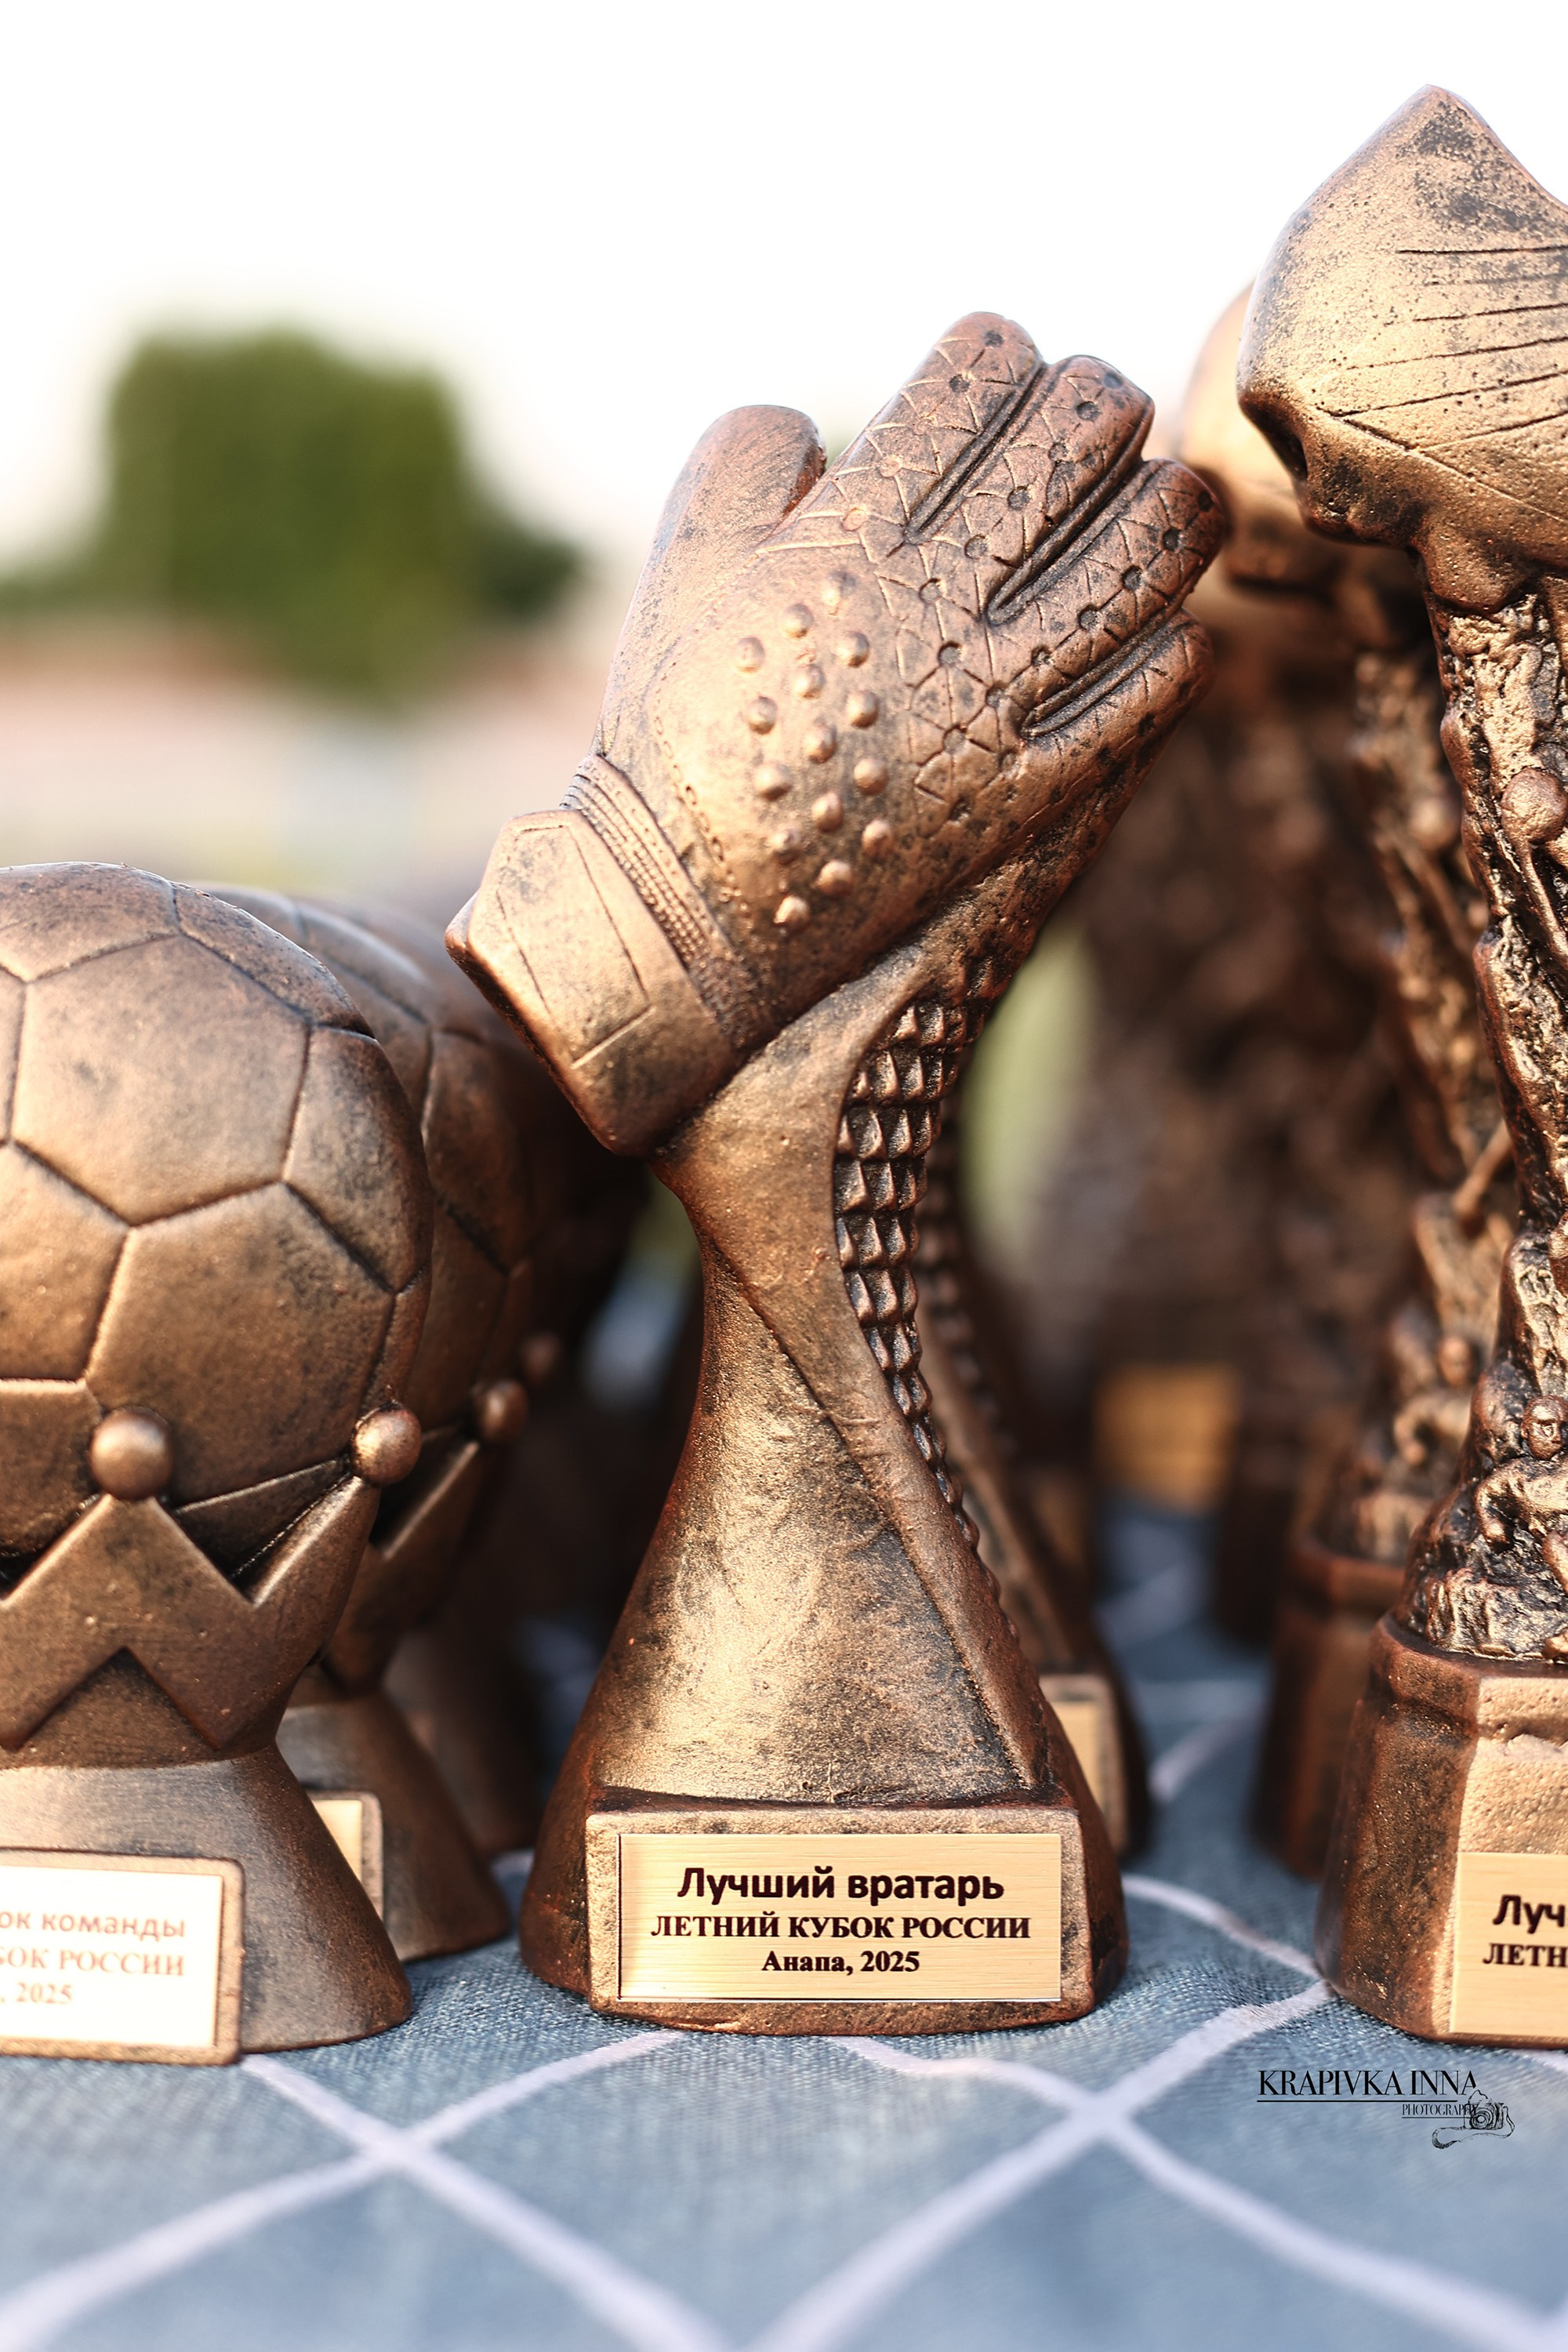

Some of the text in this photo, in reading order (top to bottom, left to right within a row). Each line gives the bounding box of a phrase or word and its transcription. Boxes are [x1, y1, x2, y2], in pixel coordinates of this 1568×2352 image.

[677, 1865, 1005, 1907] Лучший вратарь
[42, 1913, 186, 1943] команды
[651, 1911, 1032, 1939] ЛЕТНИЙ КУБОК РОССИИ
[1492, 1894, 1566, 1935] Луч
[59, 1949, 185, 1976] РОССИИ
[760, 1950, 920, 1976] Анапа, 2025
[1483, 1943, 1568, 1969] ЛЕТН
[16, 1981, 73, 2005] 2025
